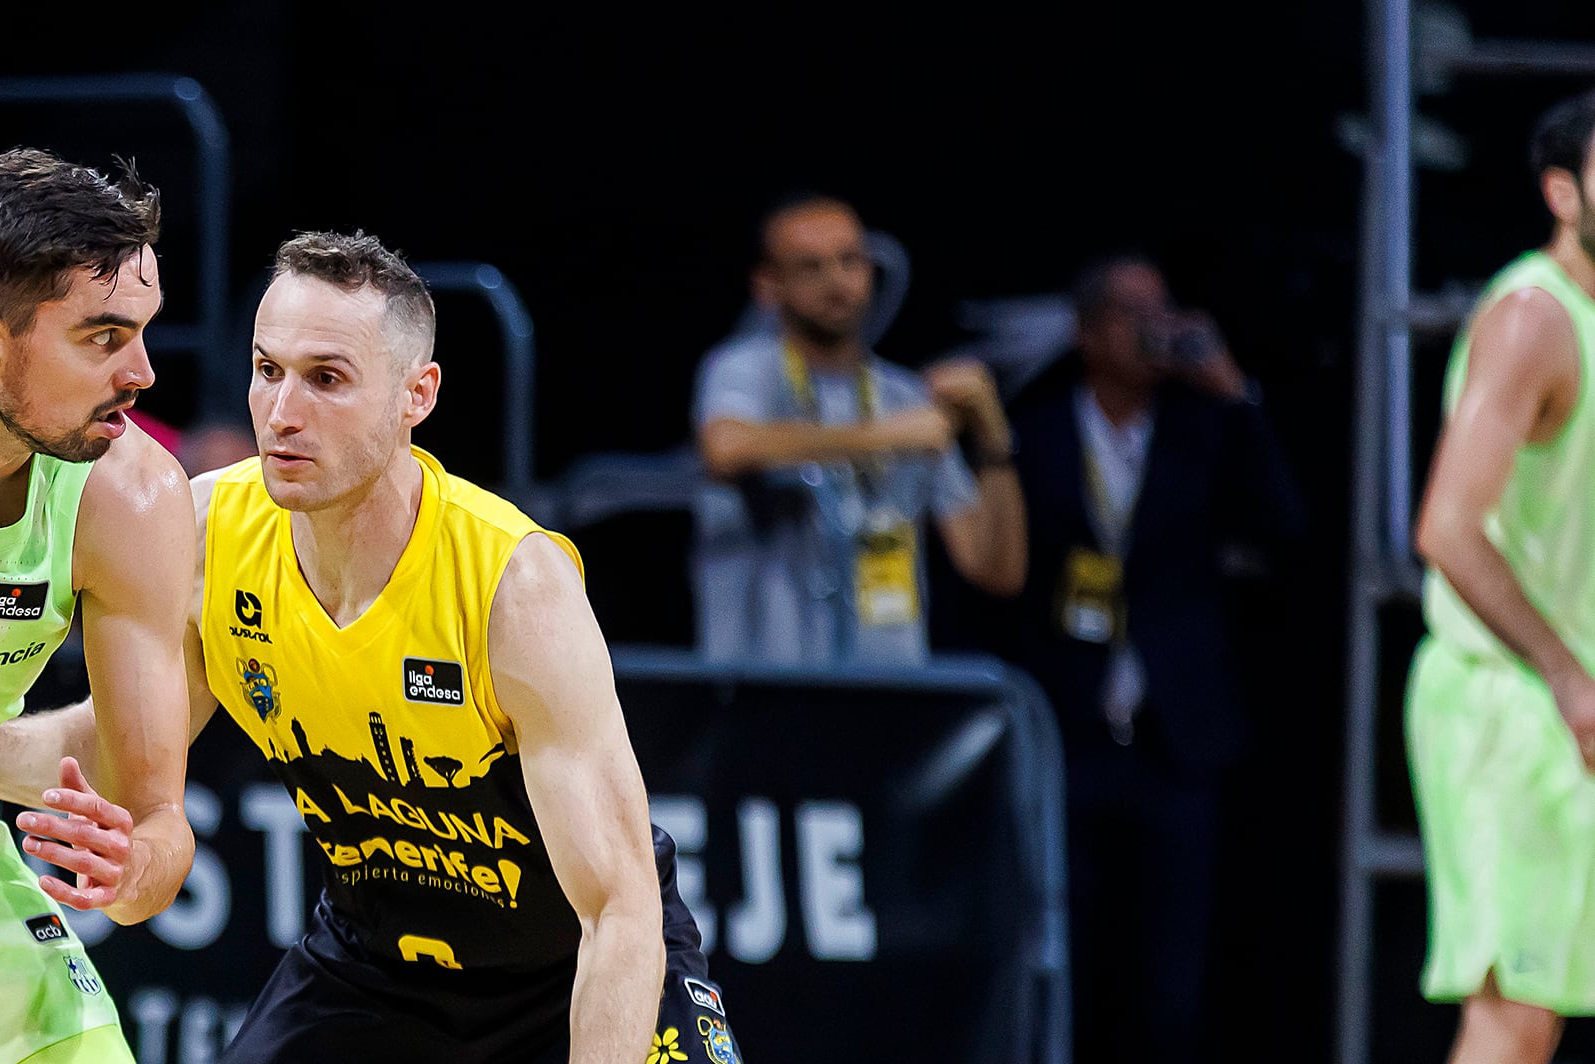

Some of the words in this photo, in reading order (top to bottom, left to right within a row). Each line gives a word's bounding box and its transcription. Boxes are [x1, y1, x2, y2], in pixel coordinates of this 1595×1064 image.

[408, 671, 433, 687] liga
[409, 686, 461, 701] endesa
[332, 783, 531, 849] LAGUNA
[36, 925, 62, 940] acb
